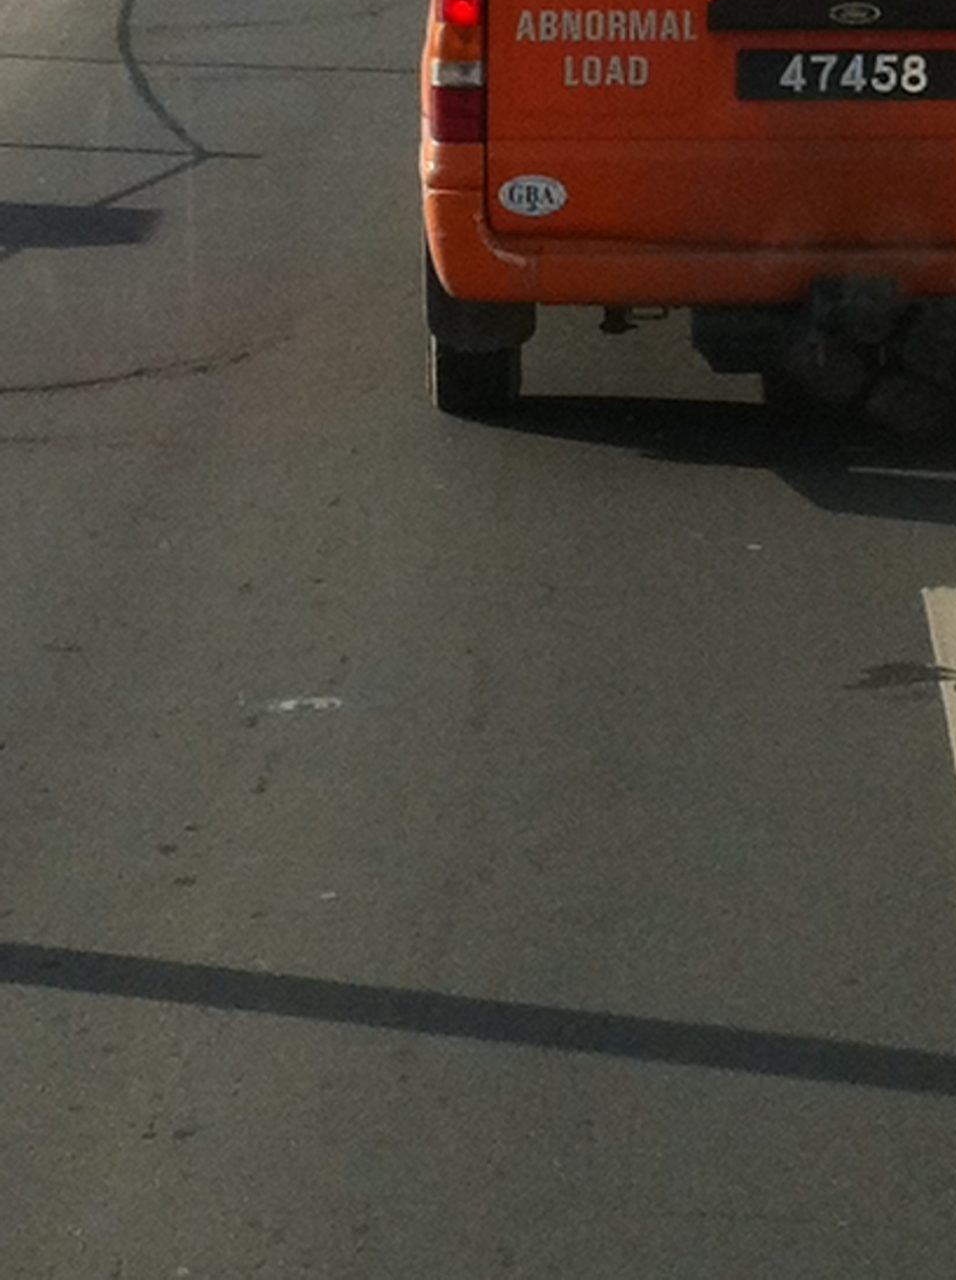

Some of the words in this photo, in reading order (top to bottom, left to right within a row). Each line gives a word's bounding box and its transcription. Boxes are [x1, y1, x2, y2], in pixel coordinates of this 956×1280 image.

[516, 9, 698, 42] ABNORMAL
[564, 54, 649, 87] LOAD
[779, 53, 928, 94] 47458
[508, 183, 557, 205] GBA
